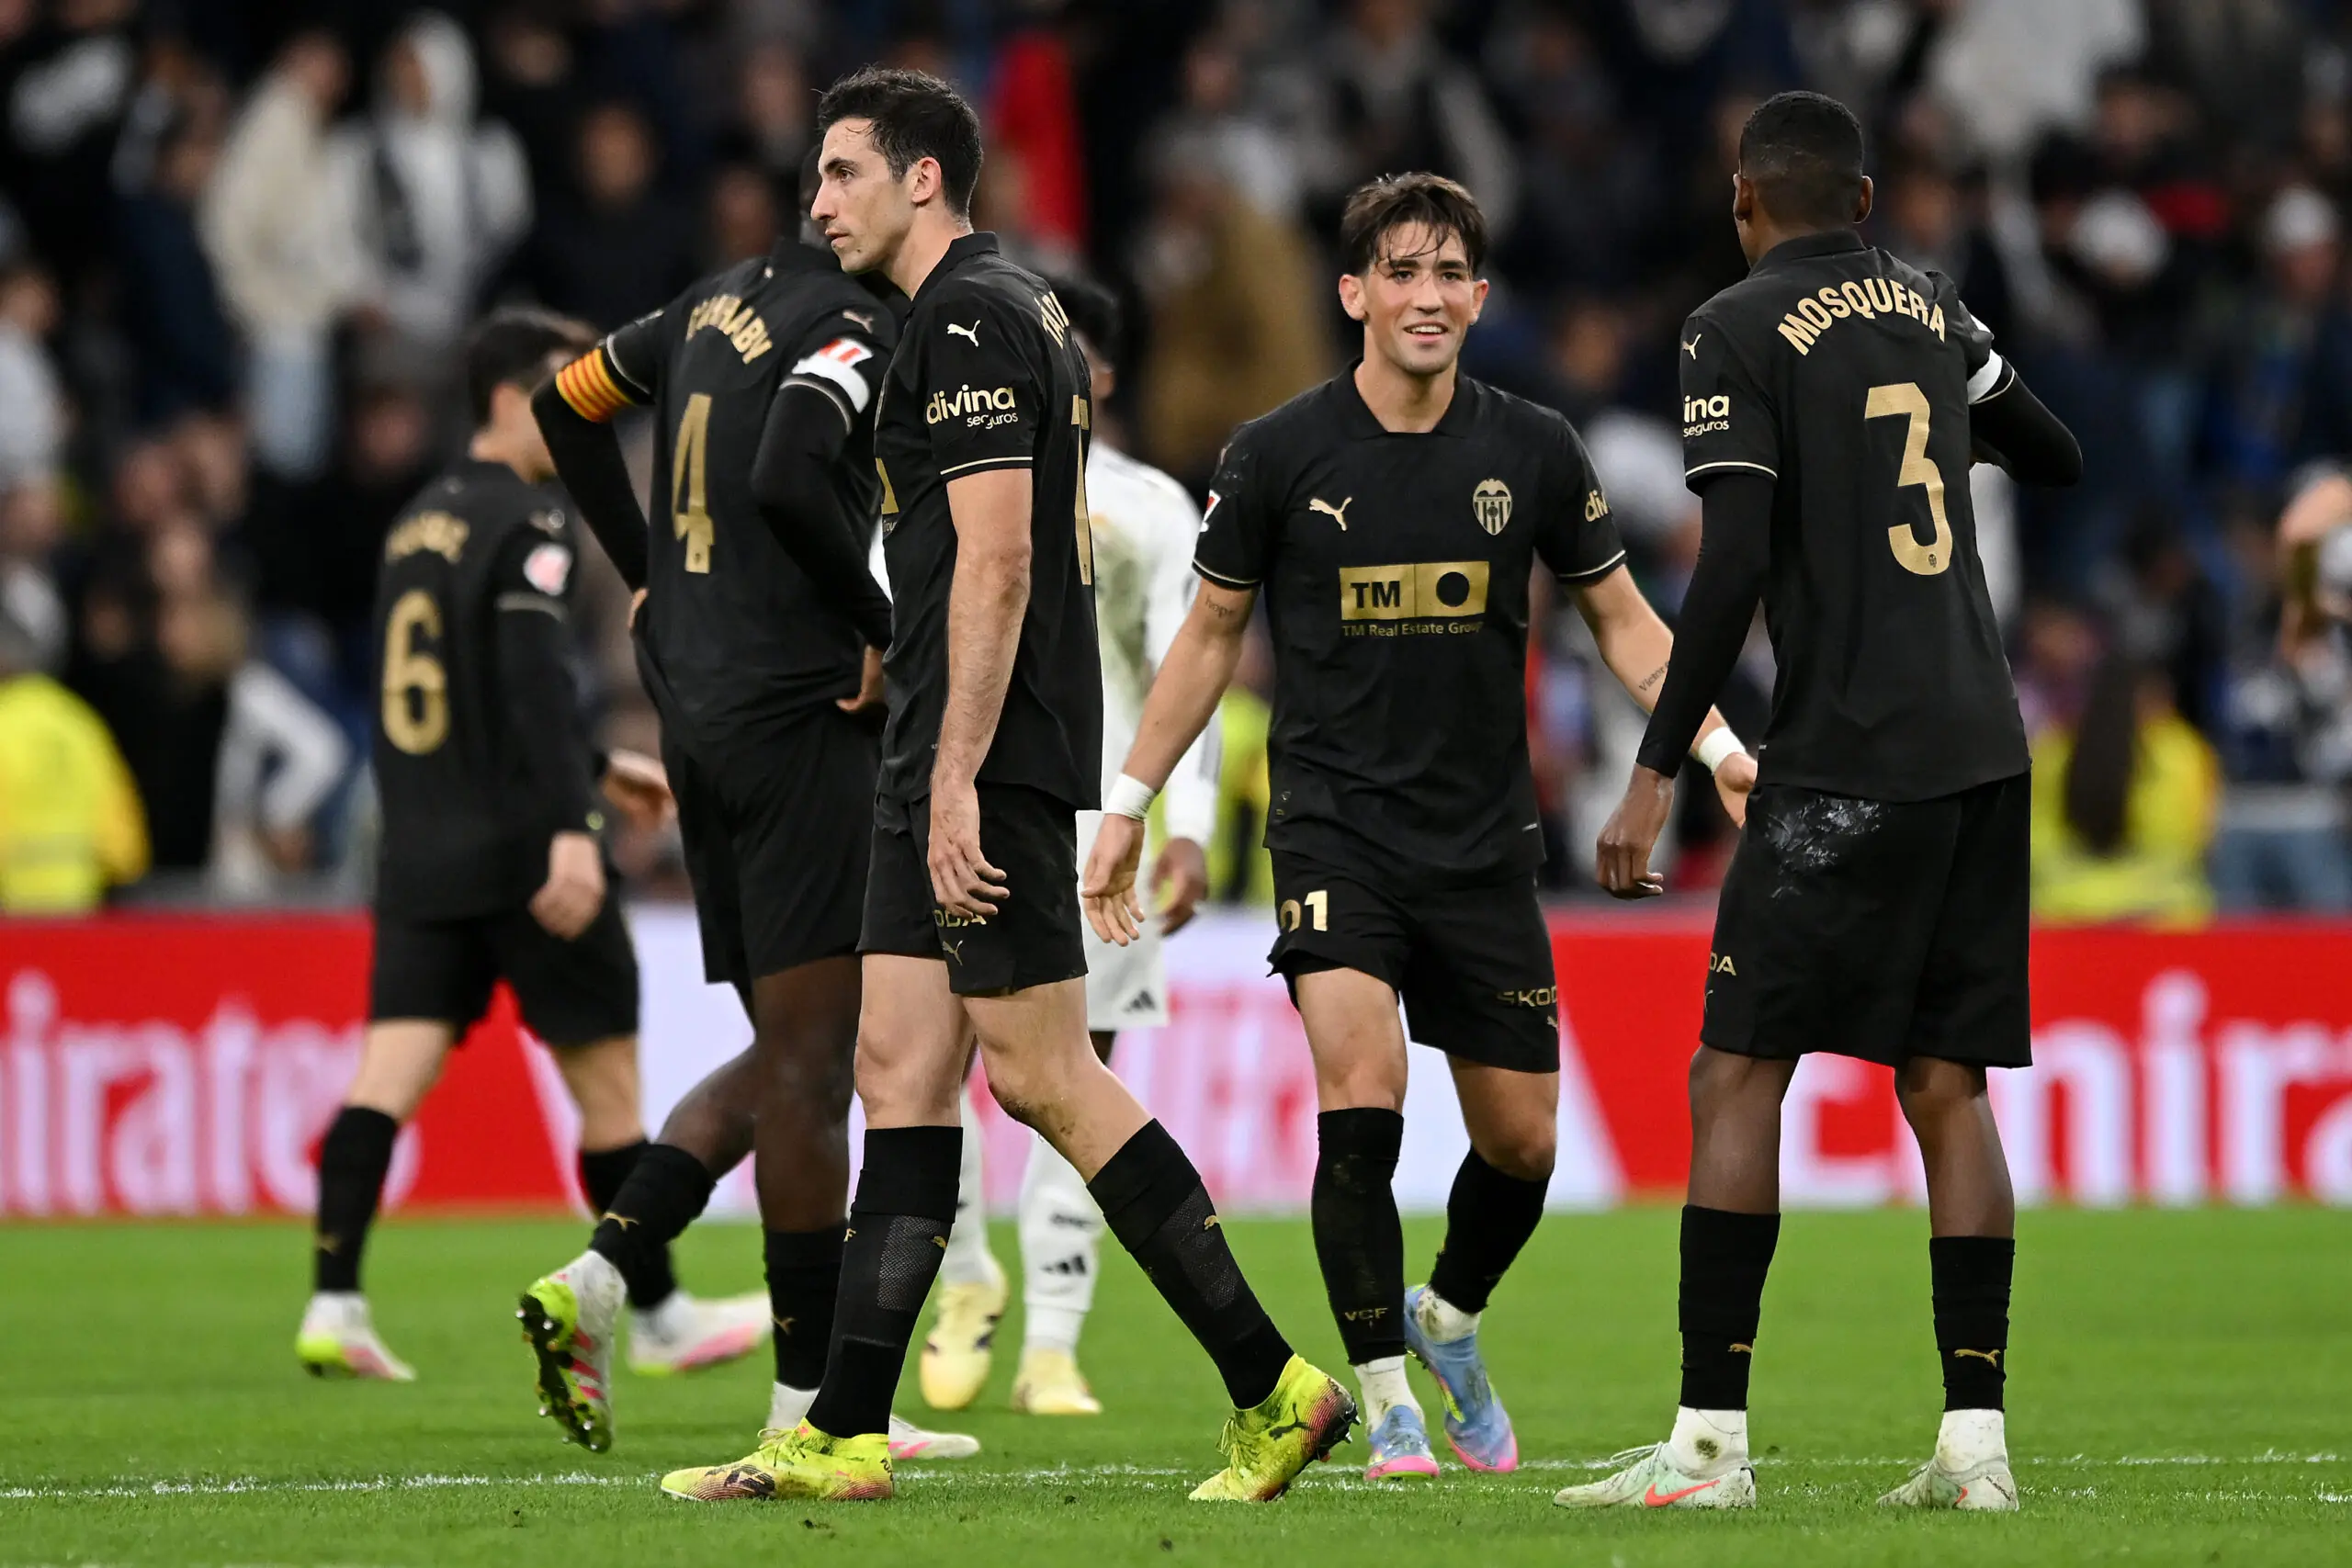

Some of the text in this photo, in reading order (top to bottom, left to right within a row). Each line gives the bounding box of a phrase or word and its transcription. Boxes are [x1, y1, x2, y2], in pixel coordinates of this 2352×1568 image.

[1778, 277, 1946, 356] MOSQUERA
[926, 384, 1016, 424] divina
[967, 412, 1019, 430] seguros
[1682, 420, 1730, 437] seguros
[673, 393, 715, 574] 4
[1864, 382, 1953, 576] 3
[1351, 581, 1401, 609] TM
[1341, 625, 1365, 637] TM
[1369, 623, 1398, 637] Real
[1401, 622, 1444, 635] Estate
[382, 587, 452, 755] 6
[1344, 1307, 1388, 1322] VCF
